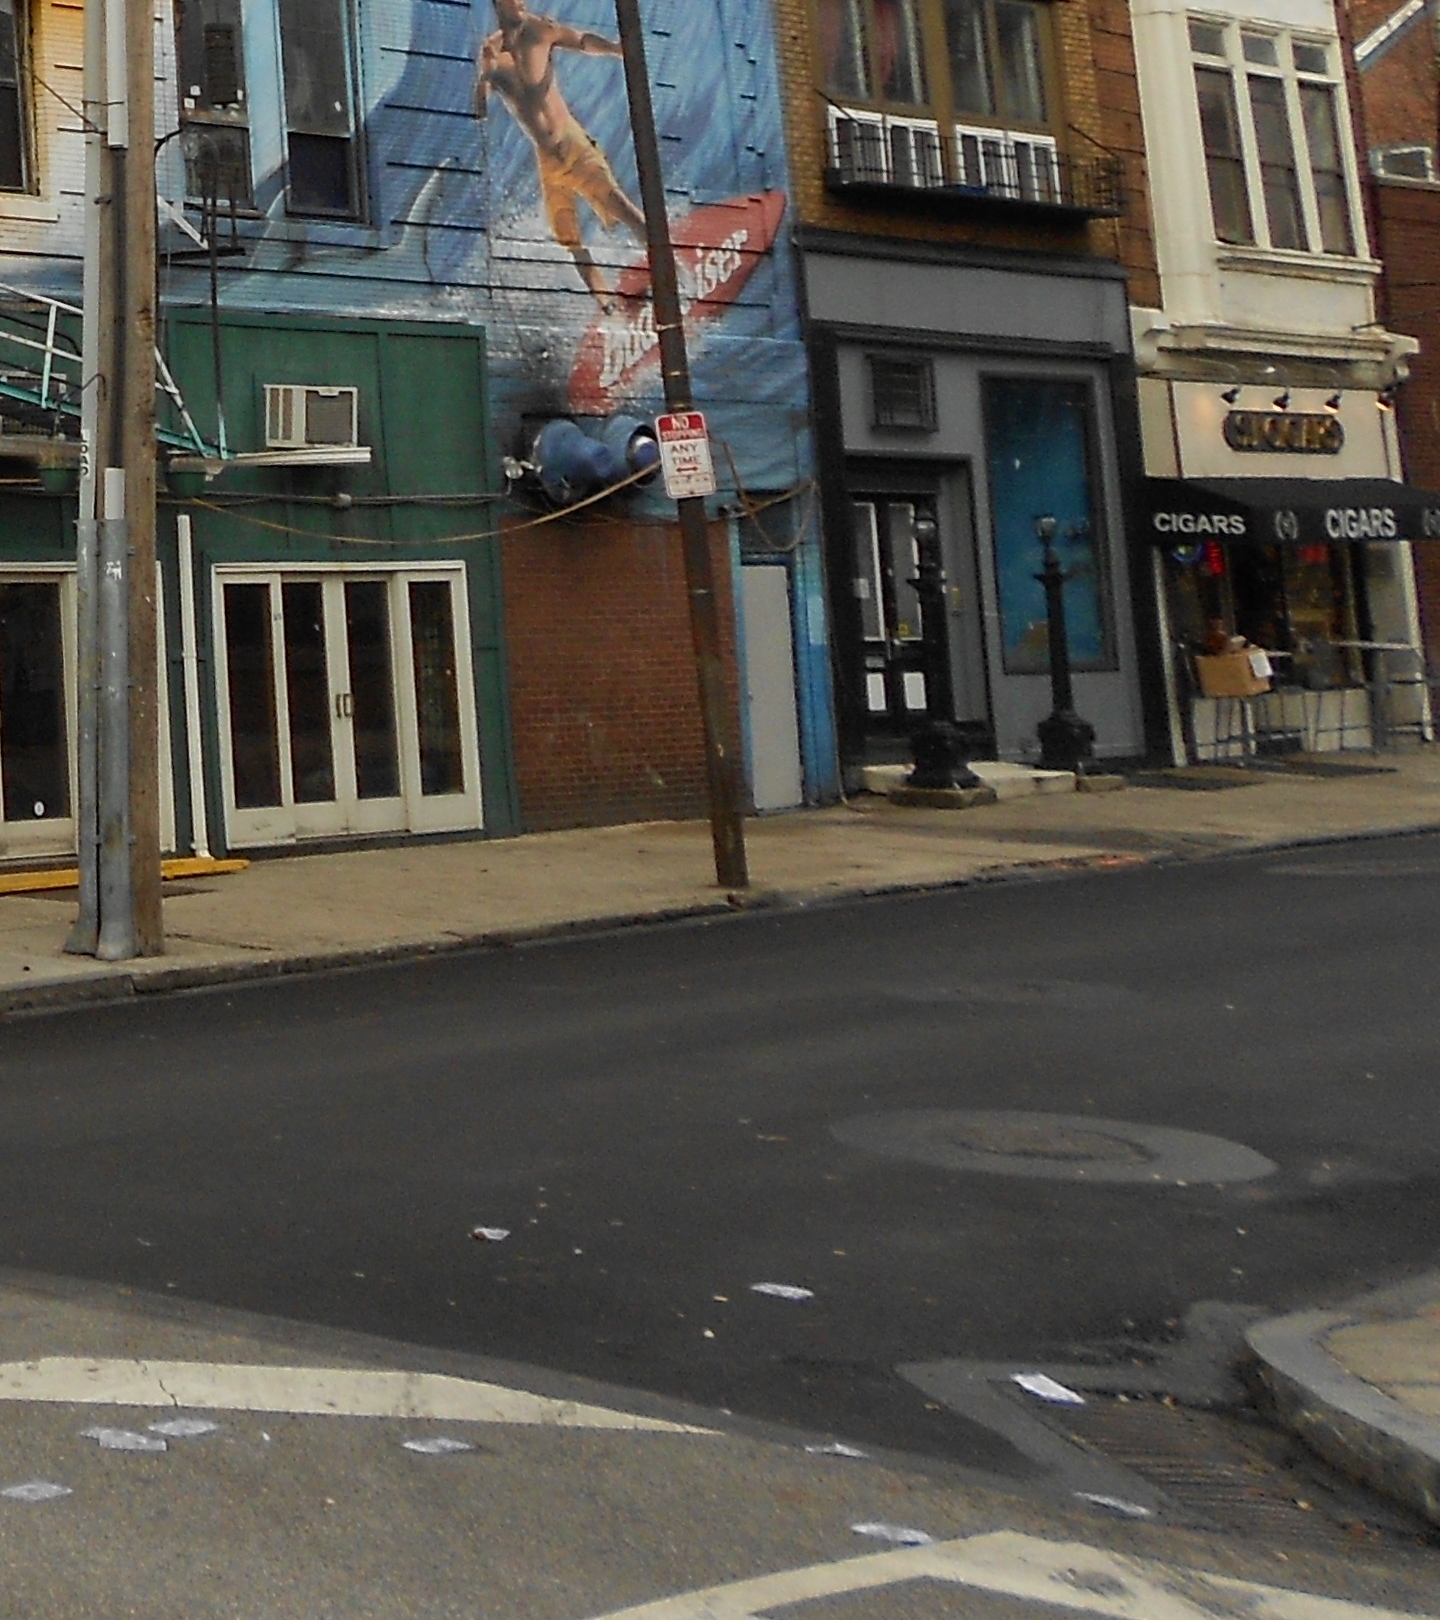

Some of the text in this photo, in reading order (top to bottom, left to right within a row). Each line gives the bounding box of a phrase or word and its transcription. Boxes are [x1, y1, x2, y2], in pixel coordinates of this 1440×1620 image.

[671, 415, 690, 429] NO
[671, 443, 698, 453] ANY
[672, 455, 702, 465] TIME
[1153, 512, 1246, 535] CIGARS
[1325, 508, 1397, 539] CIGARS
